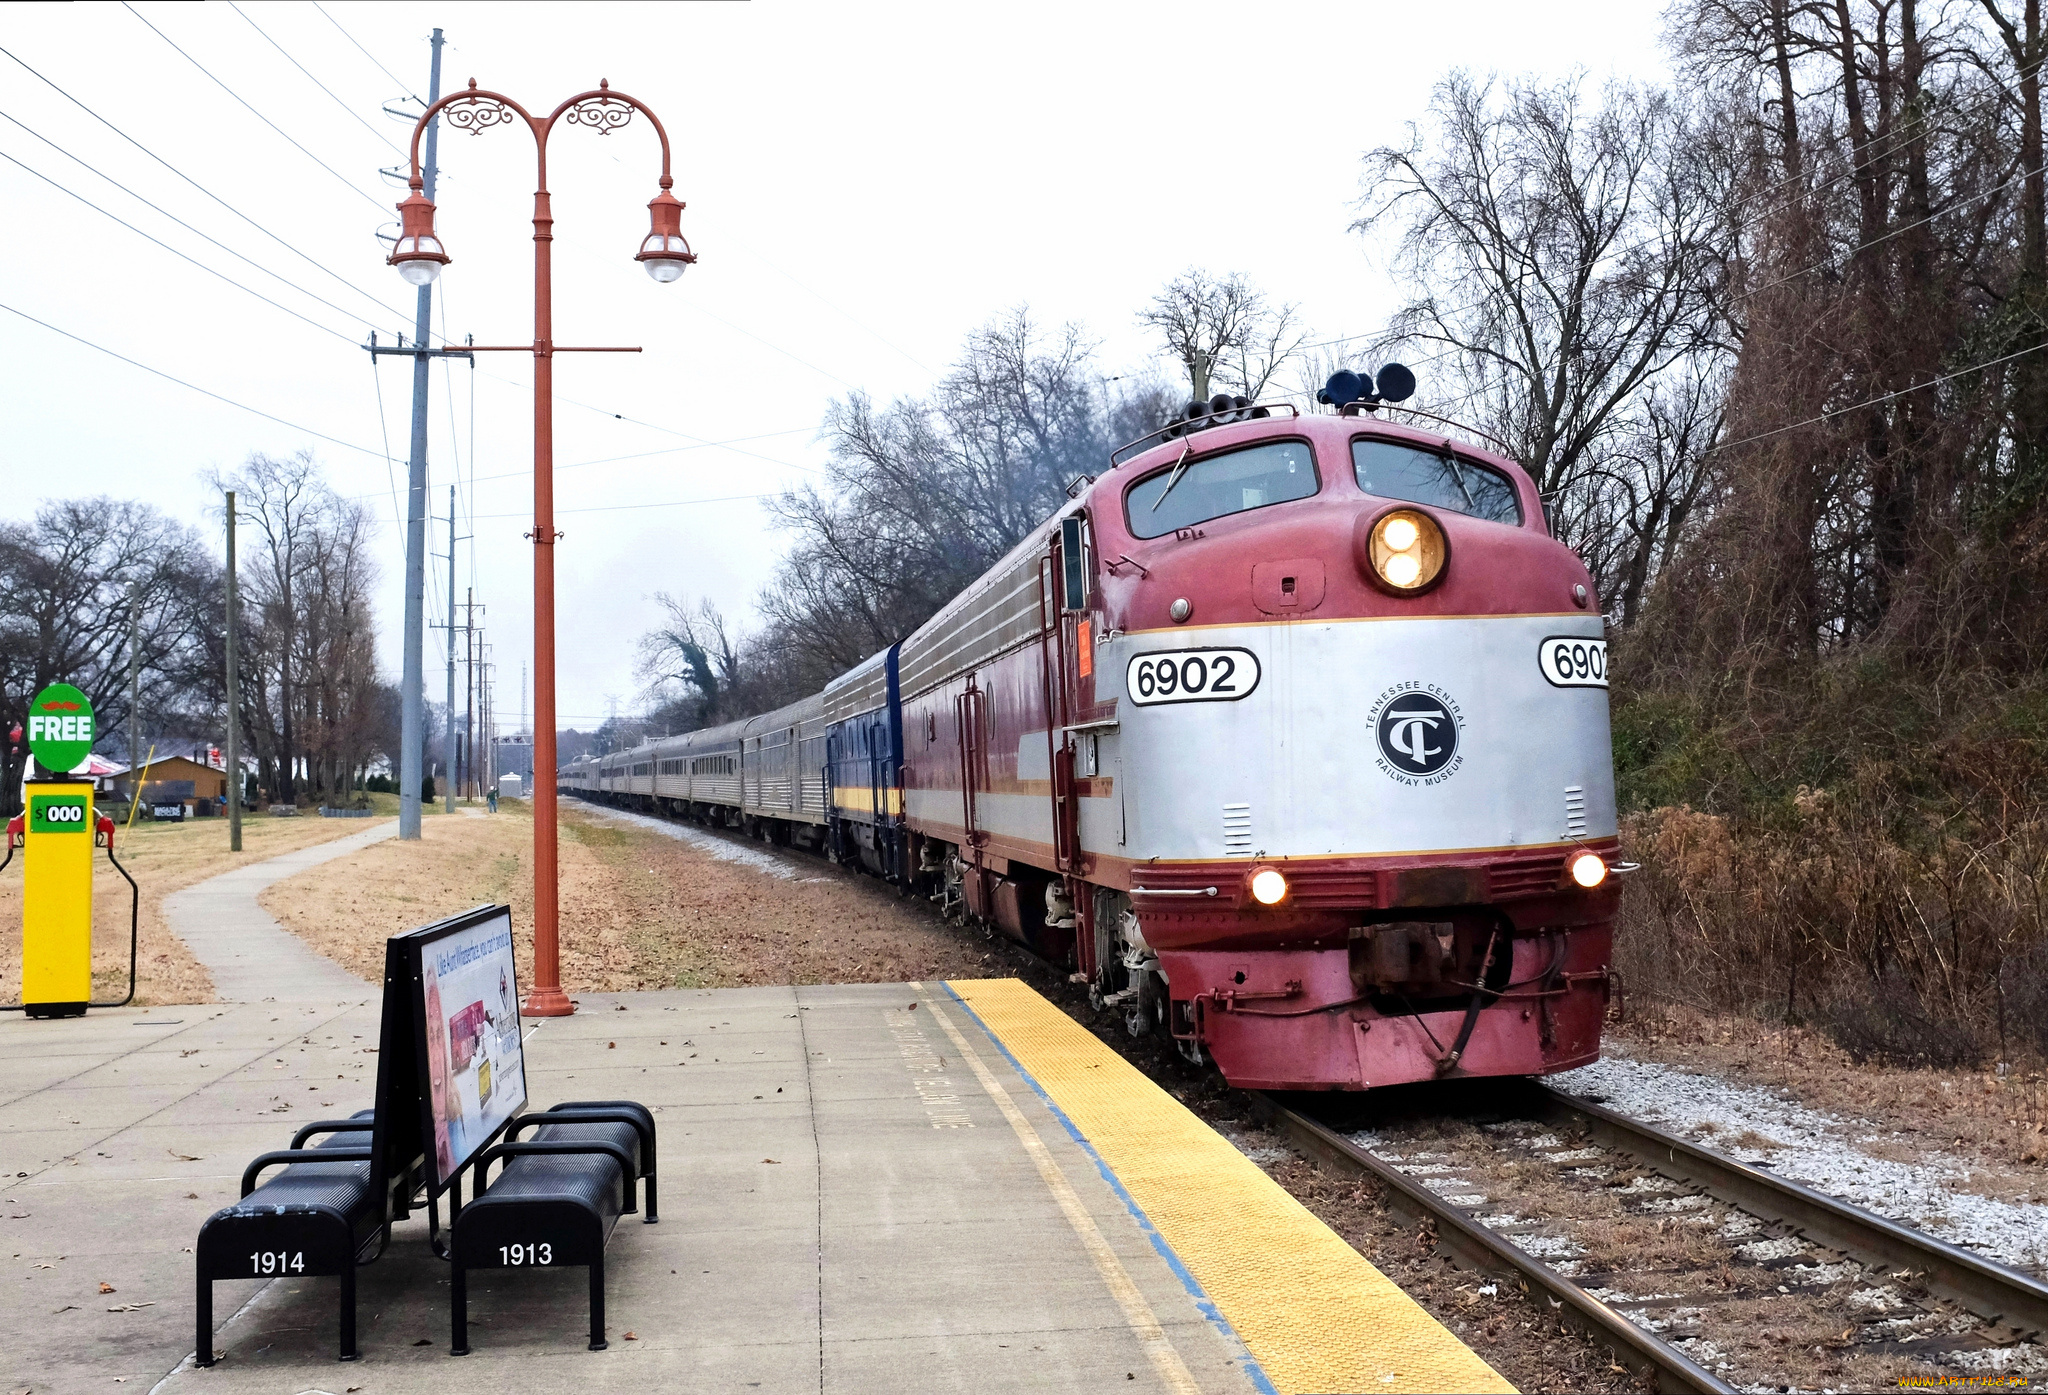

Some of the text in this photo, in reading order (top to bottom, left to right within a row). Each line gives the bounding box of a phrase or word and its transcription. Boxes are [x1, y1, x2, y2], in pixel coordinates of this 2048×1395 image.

[1138, 656, 1236, 697] 6902
[1366, 681, 1466, 730] TENNESSEE CENTRAL
[29, 716, 92, 742] FREE
[1375, 755, 1464, 787] RAILWAY MUSEUM
[48, 806, 82, 822] 000
[250, 1251, 305, 1274] 1914
[499, 1243, 552, 1266] 1913
